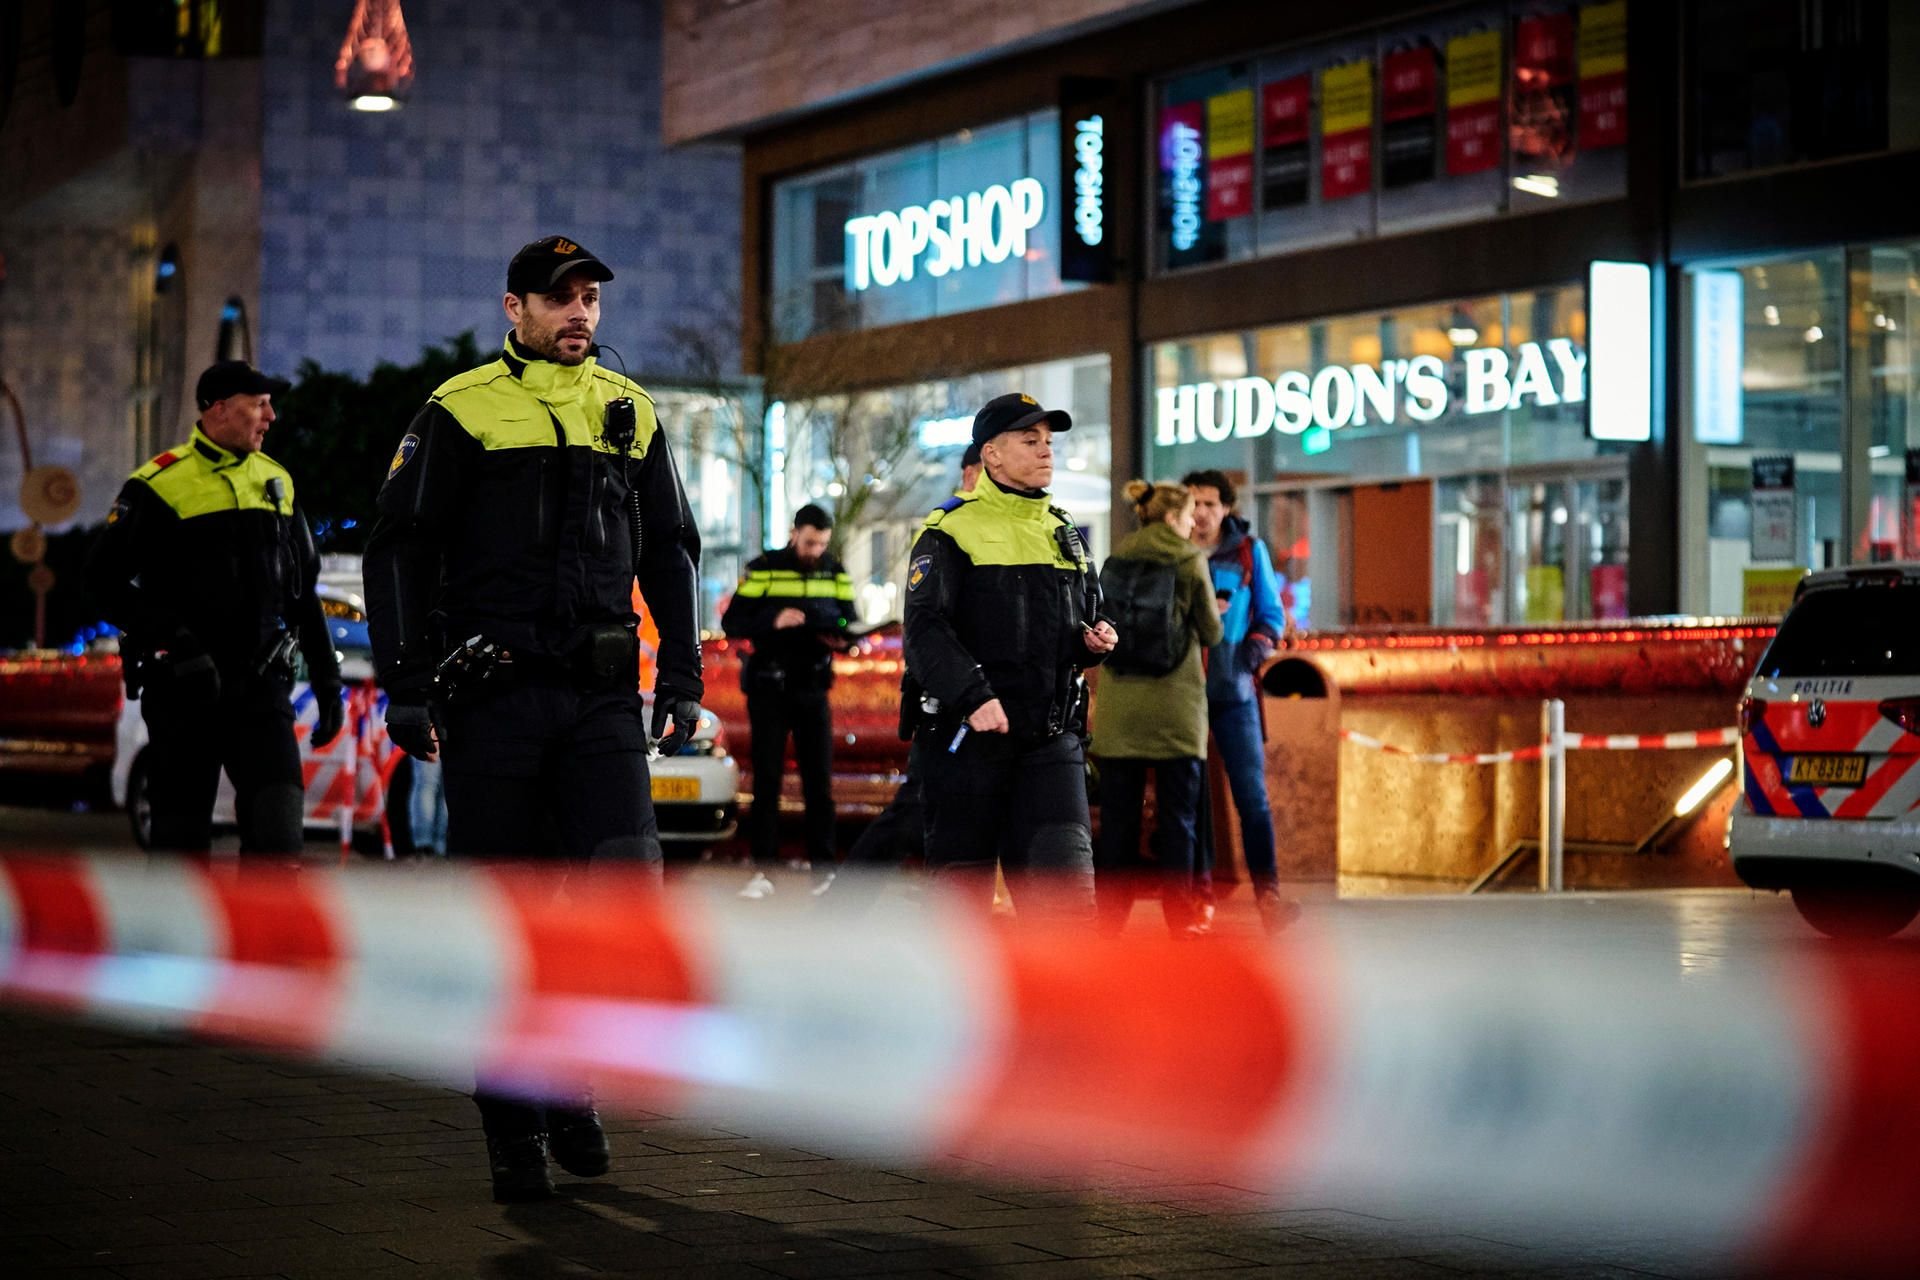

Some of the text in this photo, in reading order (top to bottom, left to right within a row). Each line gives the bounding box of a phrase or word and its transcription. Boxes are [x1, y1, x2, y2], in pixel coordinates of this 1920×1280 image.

[845, 178, 1044, 291] TOPSHOP
[1074, 114, 1104, 246] TOPSHOP
[1155, 338, 1587, 446] HUDSON'S BAY
[1794, 680, 1854, 695] POLITIE
